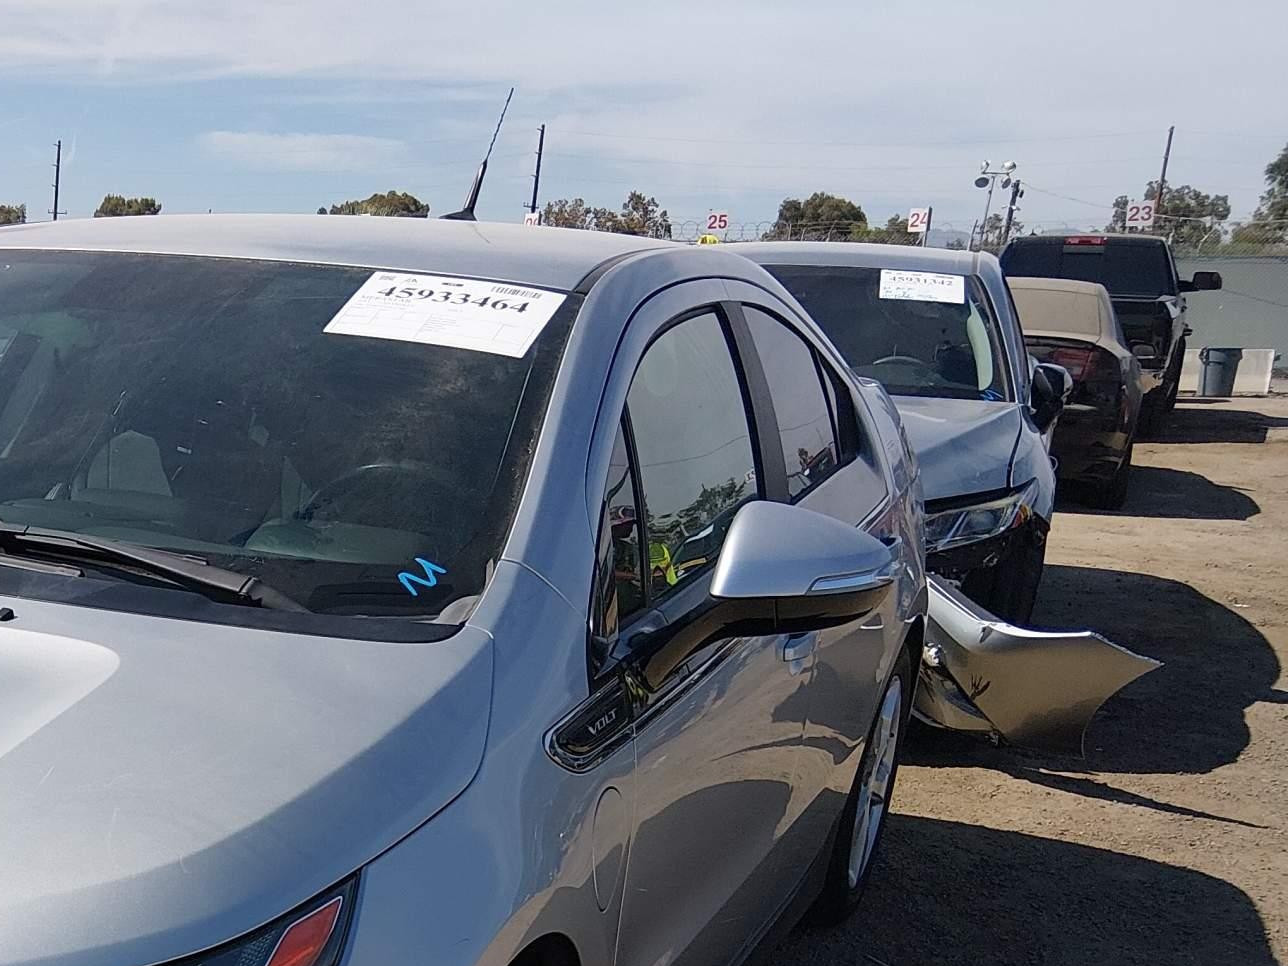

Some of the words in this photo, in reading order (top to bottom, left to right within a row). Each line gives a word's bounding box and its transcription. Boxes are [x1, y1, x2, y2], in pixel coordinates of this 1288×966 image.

[707, 214, 728, 230] 25
[1128, 205, 1153, 222] 23
[377, 285, 530, 314] 45933464
[586, 708, 617, 736] VOLT
